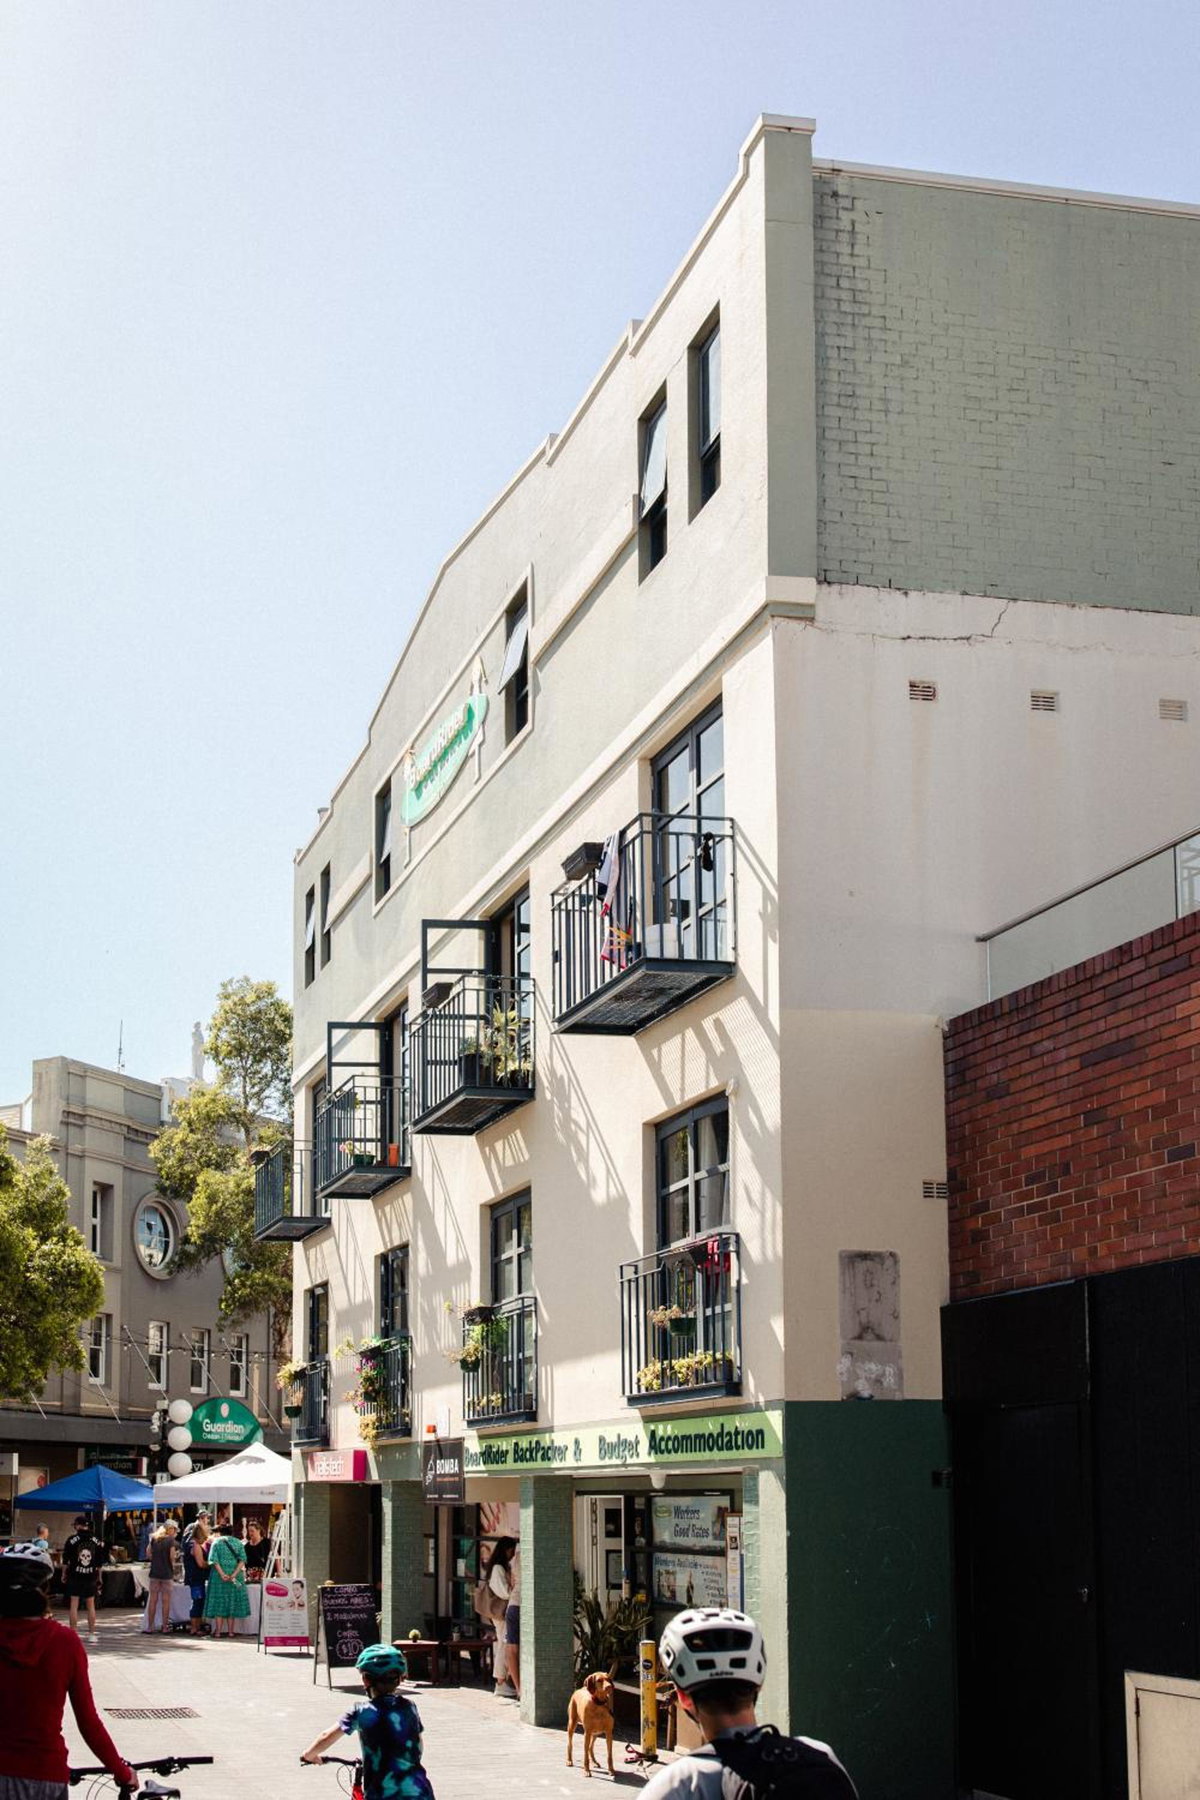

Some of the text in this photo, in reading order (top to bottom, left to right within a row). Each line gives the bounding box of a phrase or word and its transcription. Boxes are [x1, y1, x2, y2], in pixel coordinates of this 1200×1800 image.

[202, 1418, 245, 1435] Guardian
[464, 1423, 765, 1468] BoardRider BackPacker & Budget Accommodation
[436, 1458, 459, 1474] BOMBA
[673, 1505, 701, 1520] Workers
[673, 1522, 710, 1538] Good Rates
